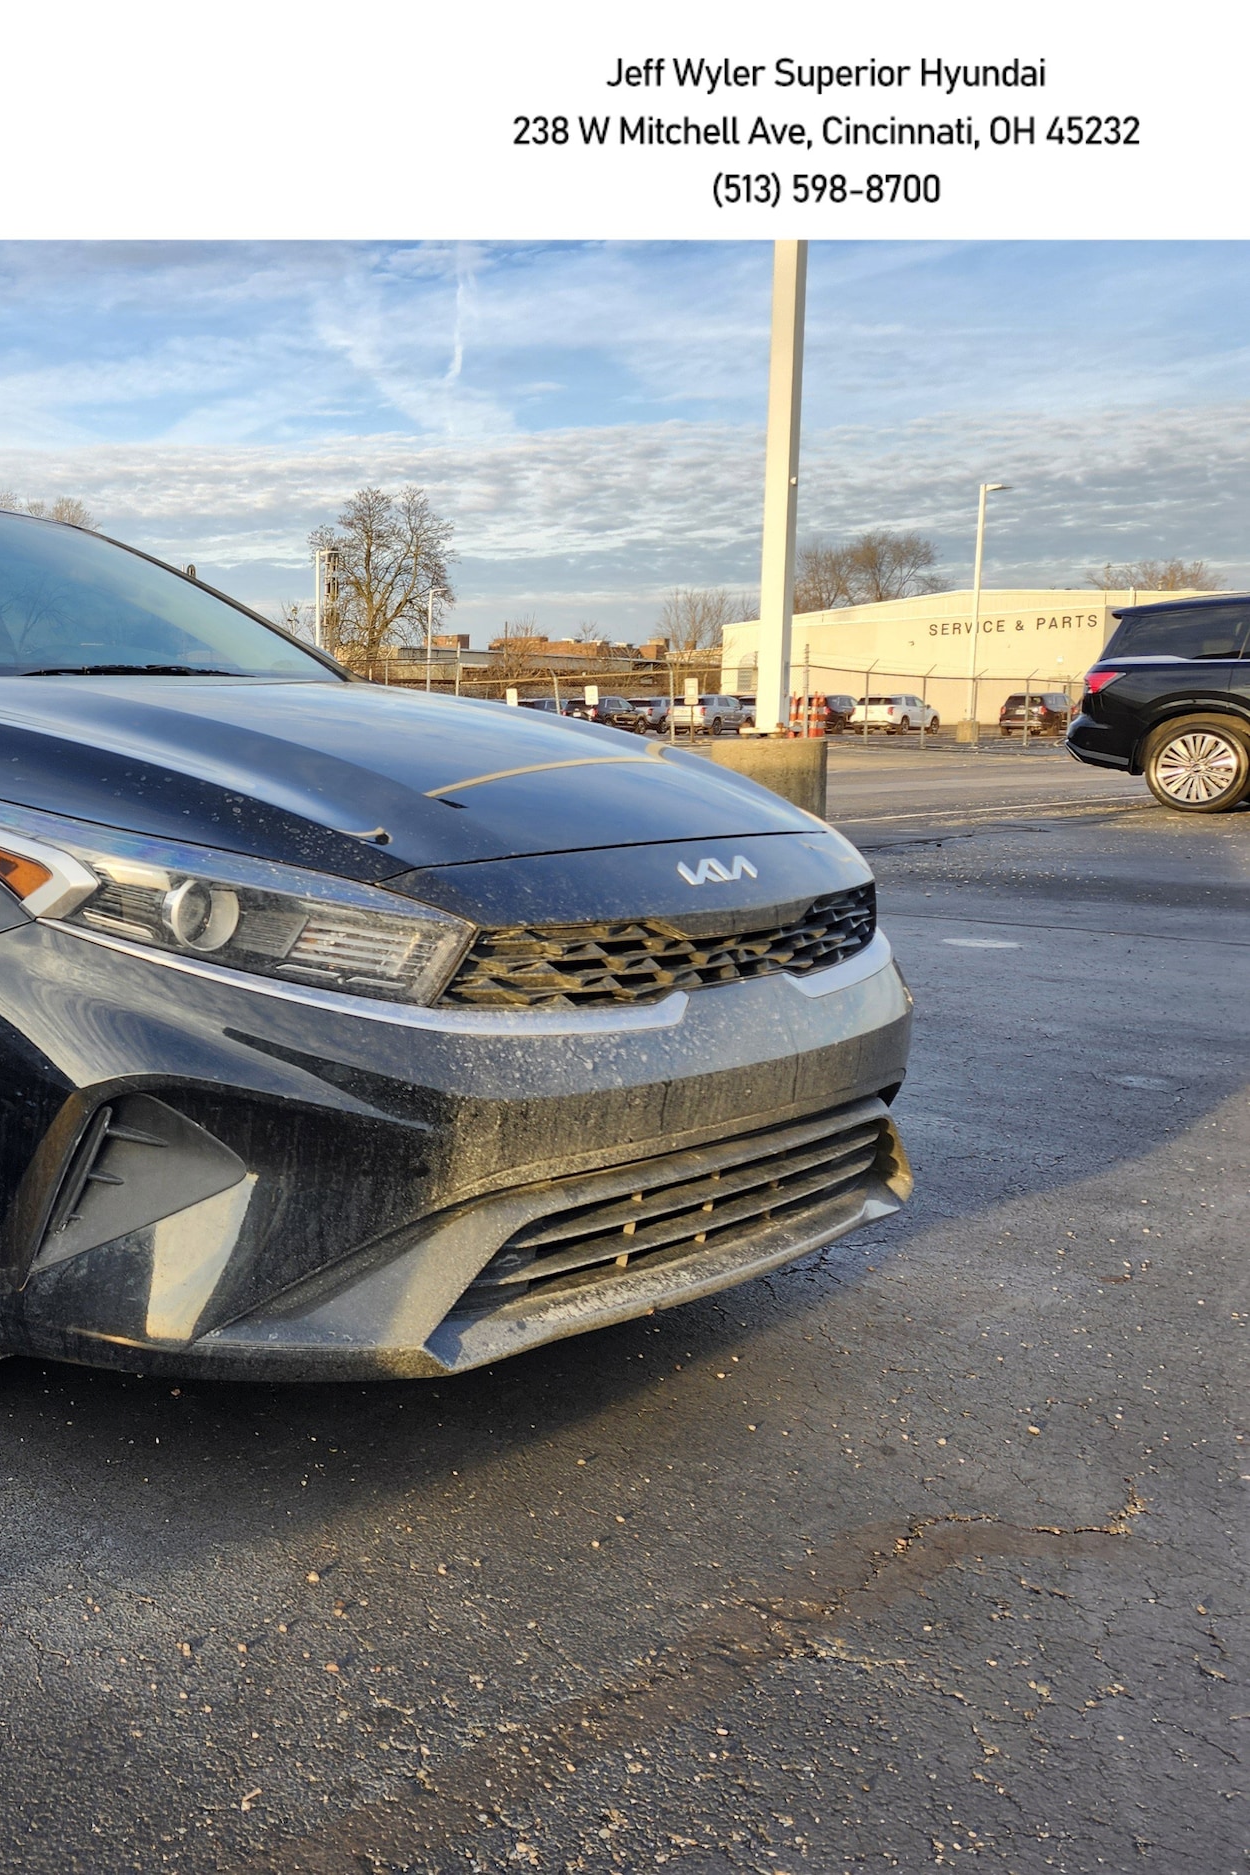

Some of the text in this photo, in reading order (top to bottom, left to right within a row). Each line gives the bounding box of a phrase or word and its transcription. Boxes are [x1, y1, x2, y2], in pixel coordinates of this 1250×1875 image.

[928, 614, 1098, 636] SERVICE & PARTS
